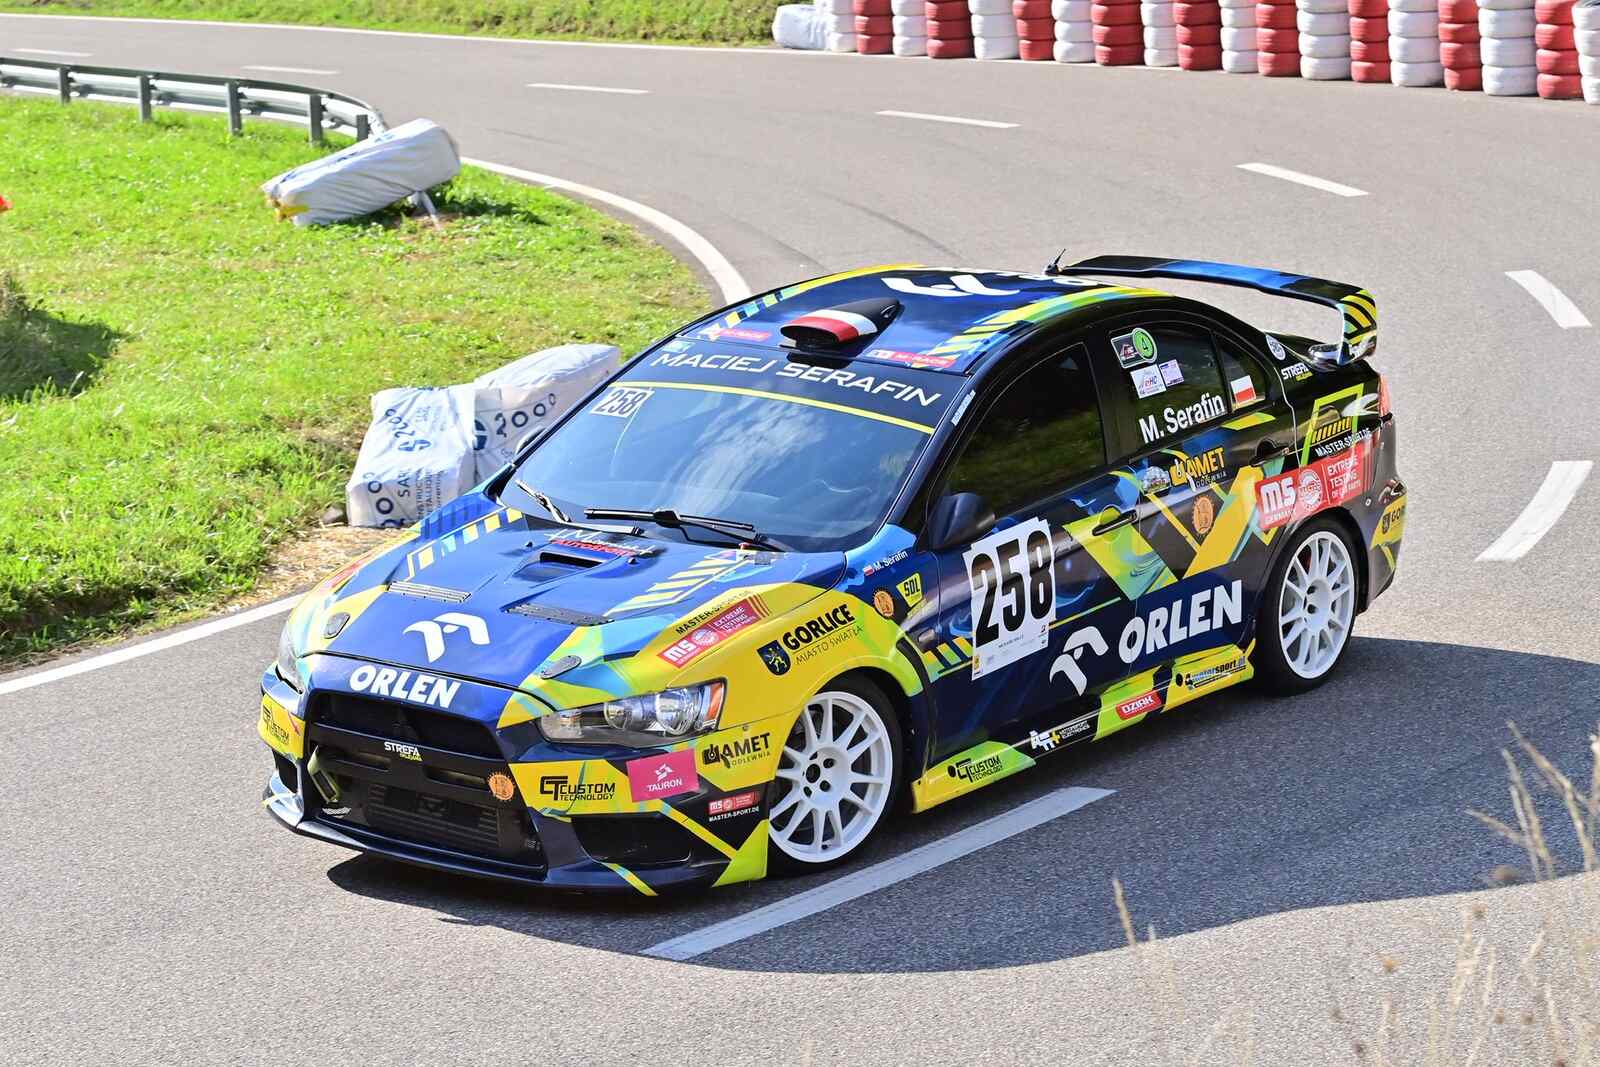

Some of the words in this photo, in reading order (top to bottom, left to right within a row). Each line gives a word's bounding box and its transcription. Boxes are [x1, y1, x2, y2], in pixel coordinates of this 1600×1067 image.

[650, 353, 778, 374] MACIEJ
[776, 363, 943, 407] SERAFIN
[596, 388, 648, 418] 258
[1138, 414, 1164, 445] M.
[1163, 392, 1226, 434] Serafin
[1260, 476, 1297, 515] MS
[884, 549, 909, 568] Serafin
[970, 529, 1052, 648] 258
[782, 603, 855, 650] GORLICE
[1118, 579, 1243, 664] ORLEN
[662, 639, 697, 662] MS
[796, 641, 830, 666] MIASTO
[349, 664, 462, 709] ORLEN
[384, 741, 421, 757] STREFA
[731, 750, 771, 767] ODLEWNIA
[968, 754, 1002, 775] CUSTOM
[560, 783, 616, 795] CUSTOM
[560, 792, 615, 801] TECHNOLOGY
[646, 778, 683, 793] TAURON
[708, 805, 760, 823] MASTER-SPORT.DE
